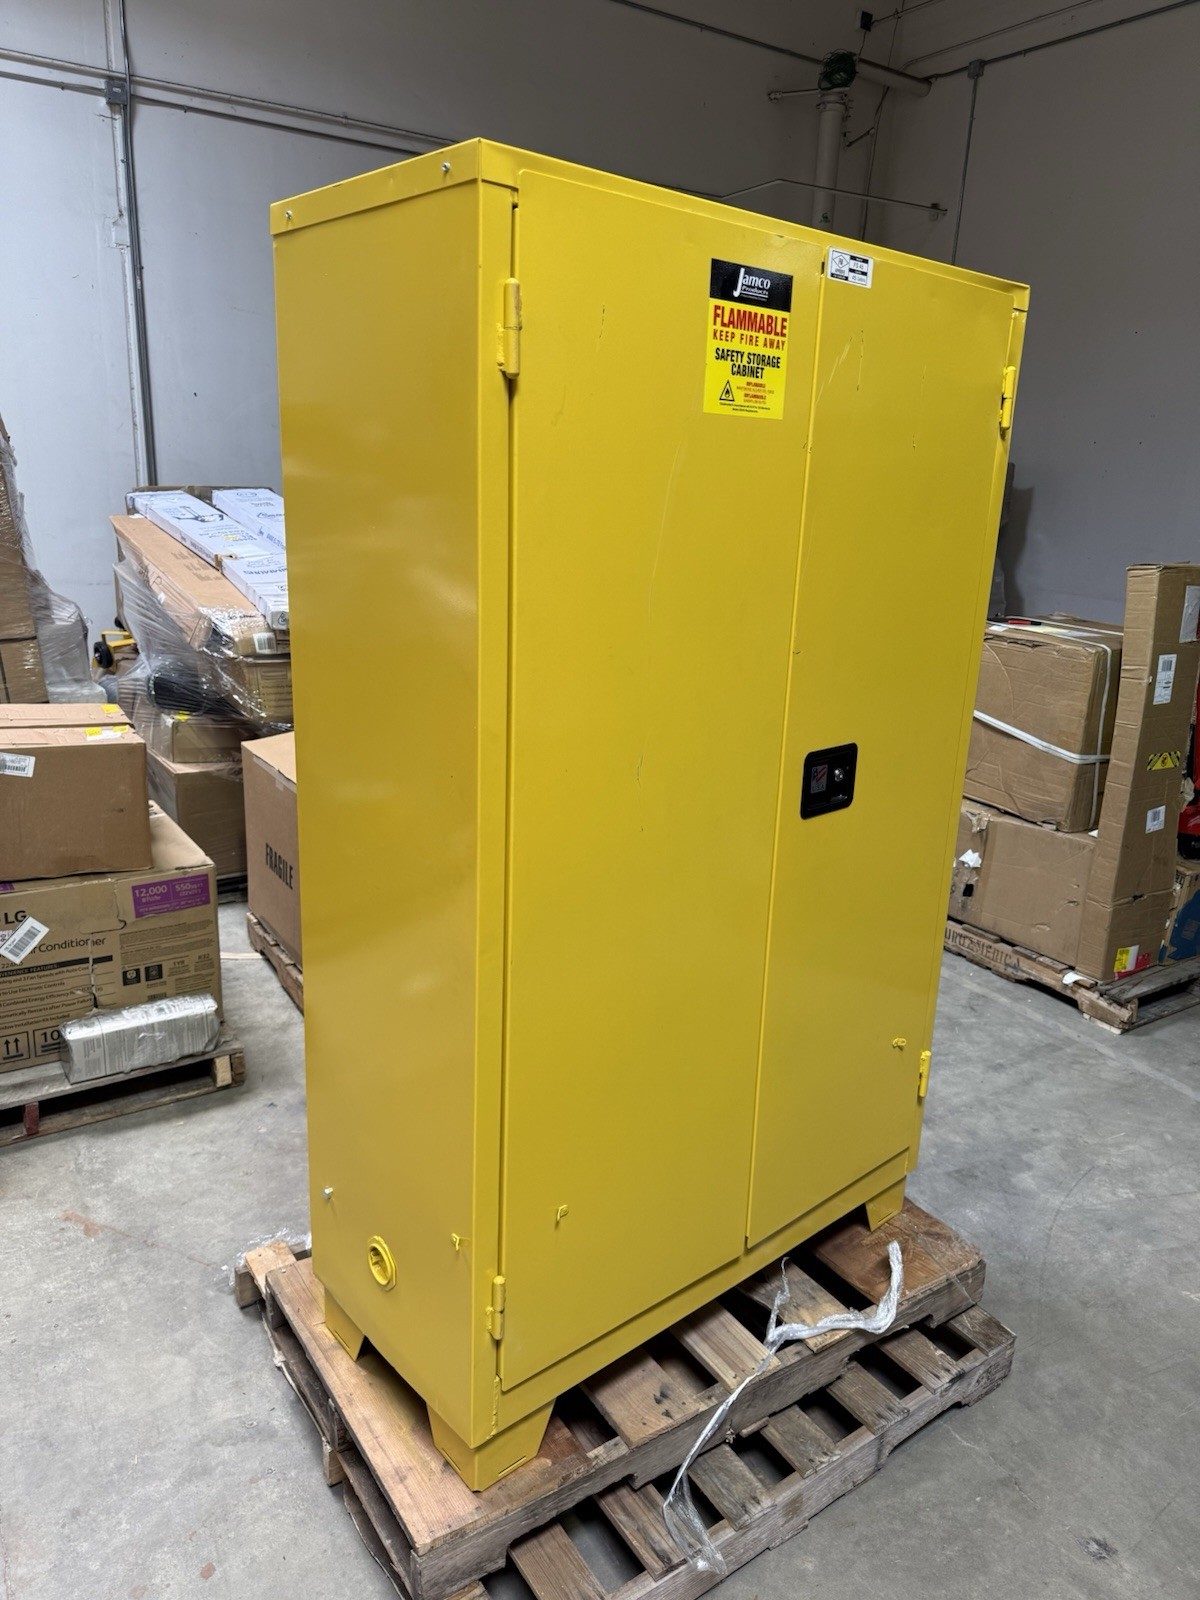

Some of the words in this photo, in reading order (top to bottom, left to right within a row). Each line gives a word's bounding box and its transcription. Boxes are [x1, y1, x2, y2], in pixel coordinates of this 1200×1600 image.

[733, 267, 771, 298] Jamco
[741, 285, 769, 295] Products
[713, 304, 788, 338] FLAMMABLE
[713, 328, 735, 343] KEEP
[740, 333, 759, 347] FIRE
[763, 337, 786, 351] AWAY
[715, 347, 745, 363] SAFETY
[747, 352, 781, 369] STORAGE
[731, 363, 765, 379] CABINET
[265, 842, 293, 890] FRAGILE
[4, 910, 28, 924] LG
[28, 996, 45, 1004] Energy
[46, 992, 69, 1000] Efficiency
[14, 1019, 41, 1028] Installation
[50, 1013, 70, 1021] Included
